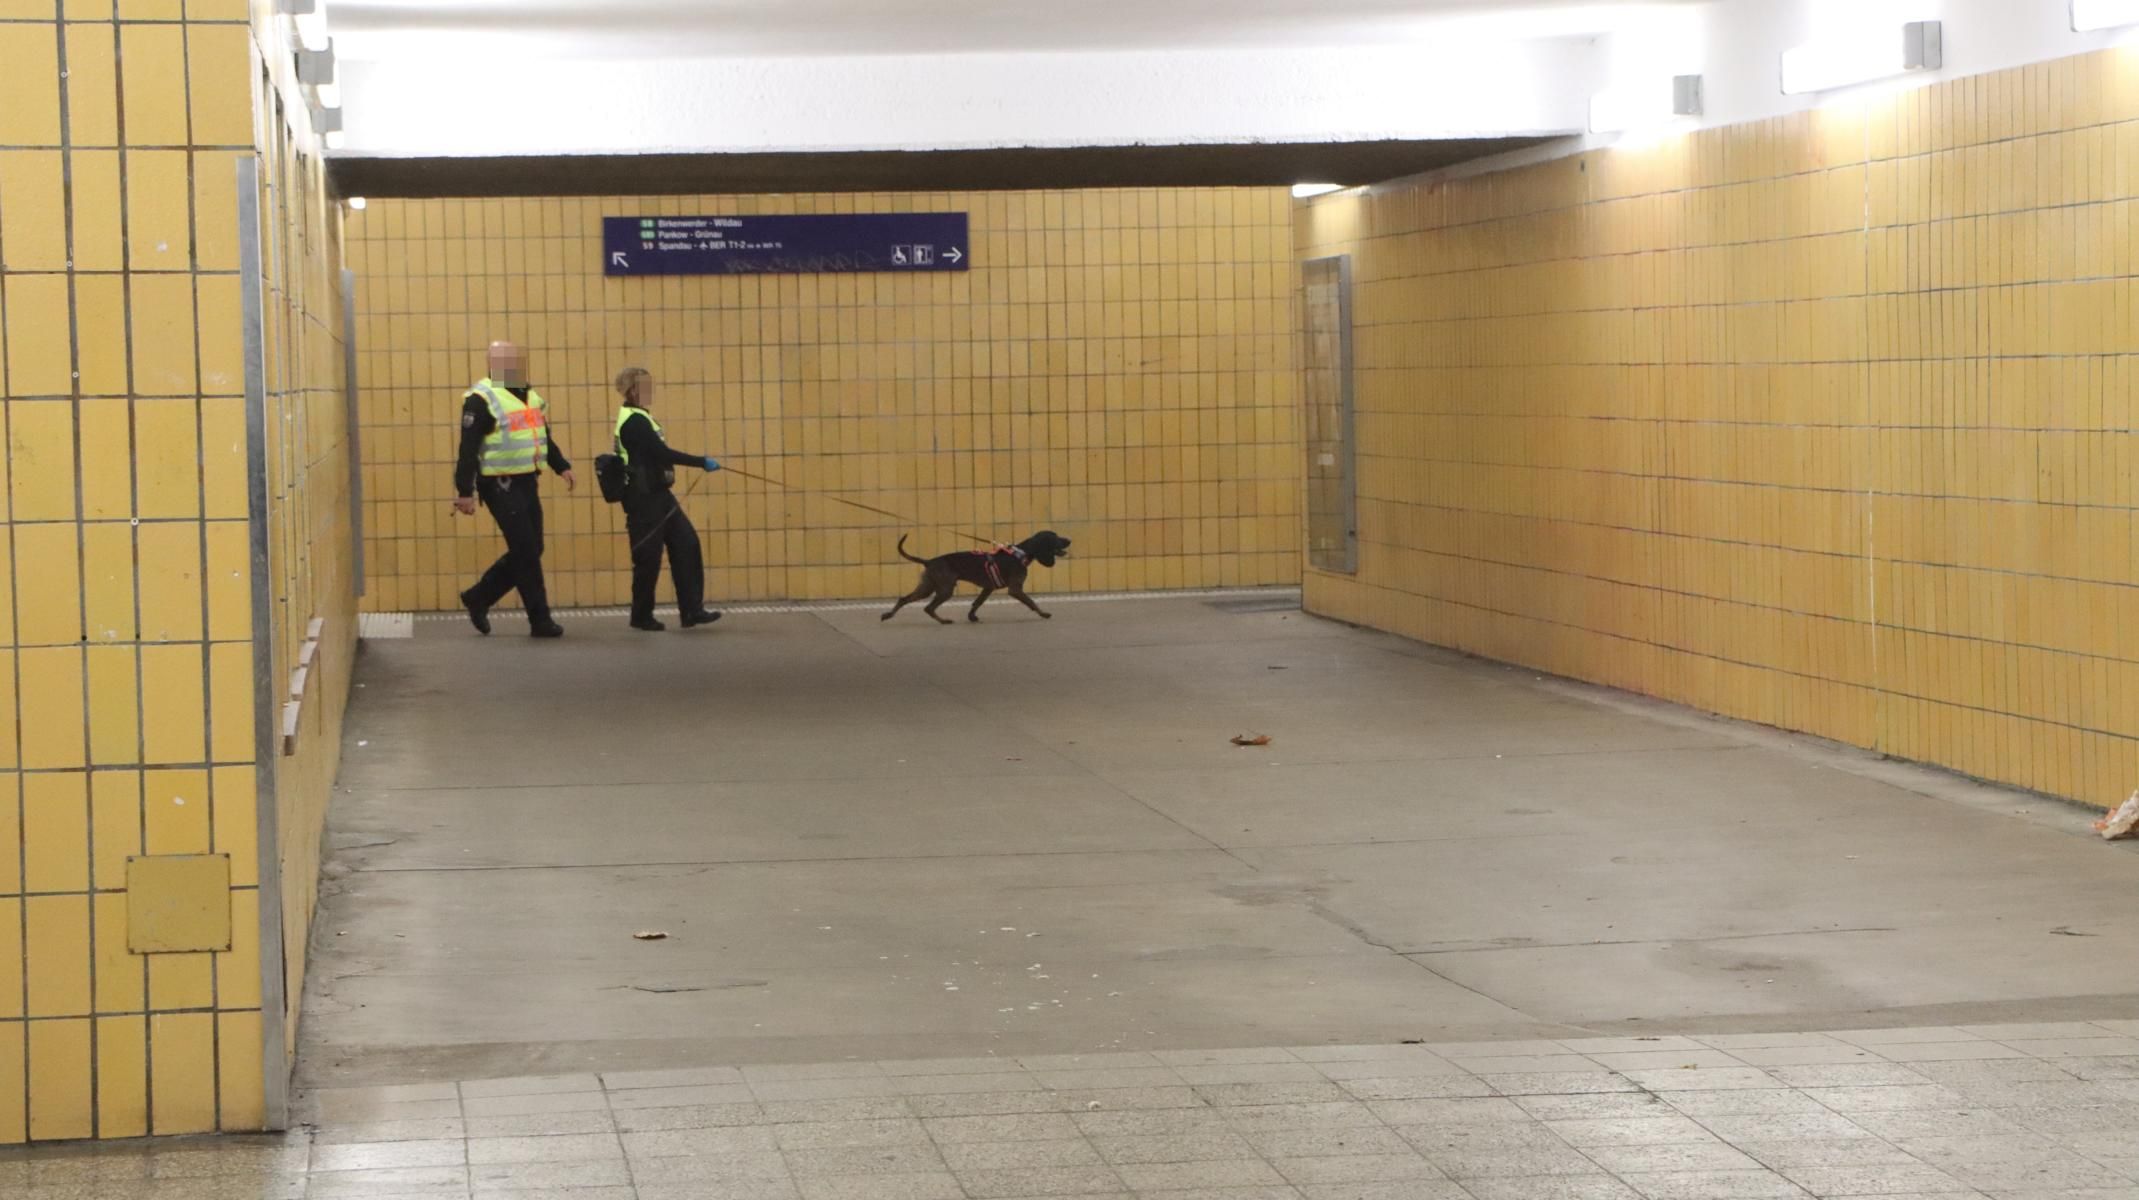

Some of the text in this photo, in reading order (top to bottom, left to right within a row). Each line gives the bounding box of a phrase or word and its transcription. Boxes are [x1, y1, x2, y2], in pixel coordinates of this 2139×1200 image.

[658, 219, 708, 228] Birkenwerder
[713, 218, 743, 227] Wildau
[658, 230, 688, 239] Pankow
[694, 230, 723, 239] Grünau
[642, 241, 654, 250] S9
[658, 241, 693, 251] Spandau
[709, 240, 726, 249] BER
